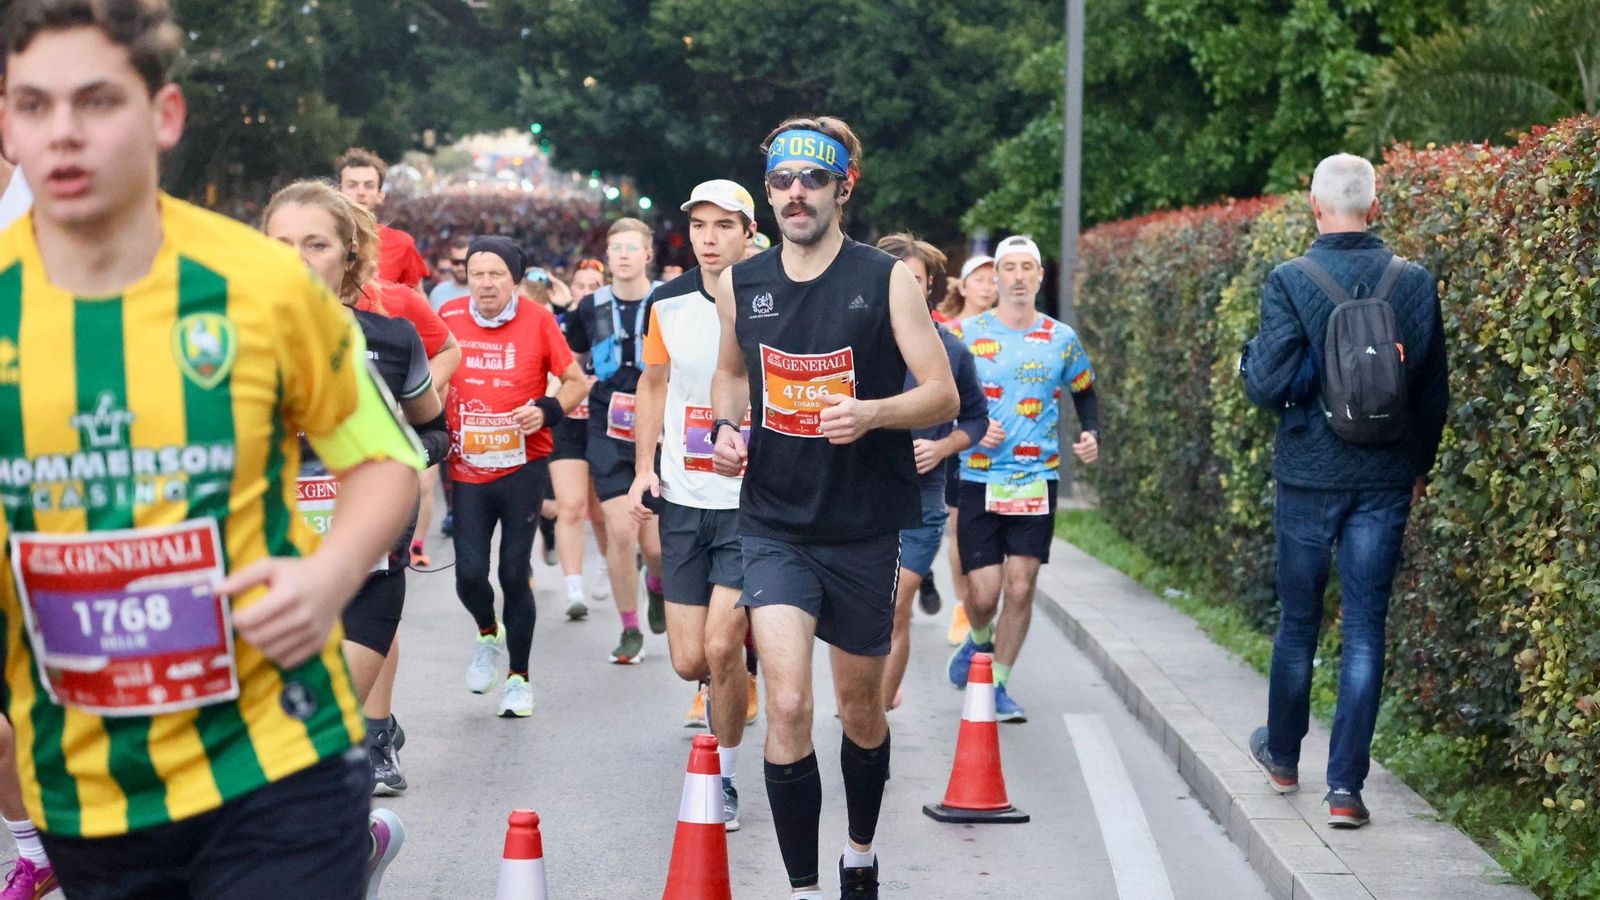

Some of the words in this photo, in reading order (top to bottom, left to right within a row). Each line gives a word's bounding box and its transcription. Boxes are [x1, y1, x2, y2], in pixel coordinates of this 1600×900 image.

[466, 355, 503, 370] MÁLAGA
[782, 354, 847, 372] GENERALI
[783, 384, 830, 401] 4766
[475, 416, 517, 425] GENERAL
[473, 433, 511, 445] 17190
[32, 479, 188, 511] CASINO
[304, 482, 338, 499] GEN
[64, 533, 203, 575] GENERALI
[71, 593, 173, 637] 1768
